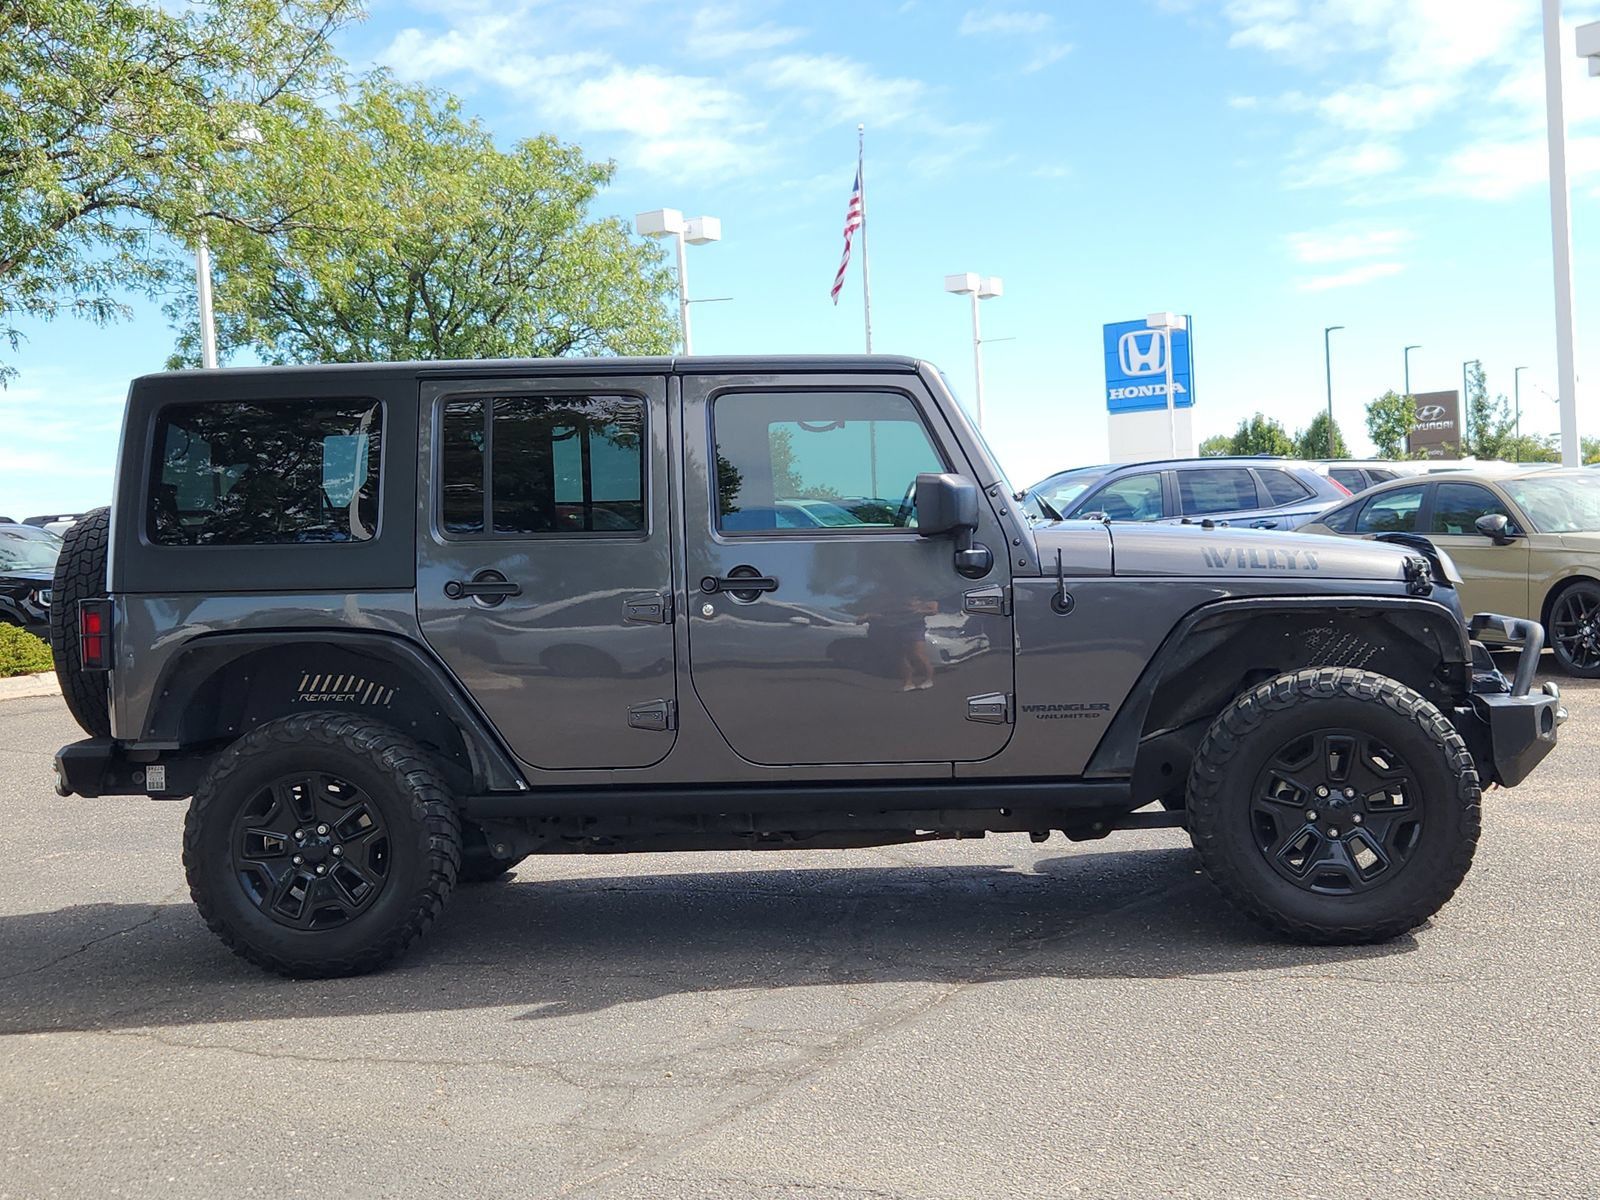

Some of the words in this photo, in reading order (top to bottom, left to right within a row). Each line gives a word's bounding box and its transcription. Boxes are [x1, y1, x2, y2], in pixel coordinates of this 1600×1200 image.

[1109, 382, 1187, 400] HONDA
[1200, 546, 1320, 570] WILLYS
[299, 693, 356, 702] REAPER
[1022, 703, 1110, 712] WRANGLER
[1036, 712, 1101, 720] UNLIMITED
